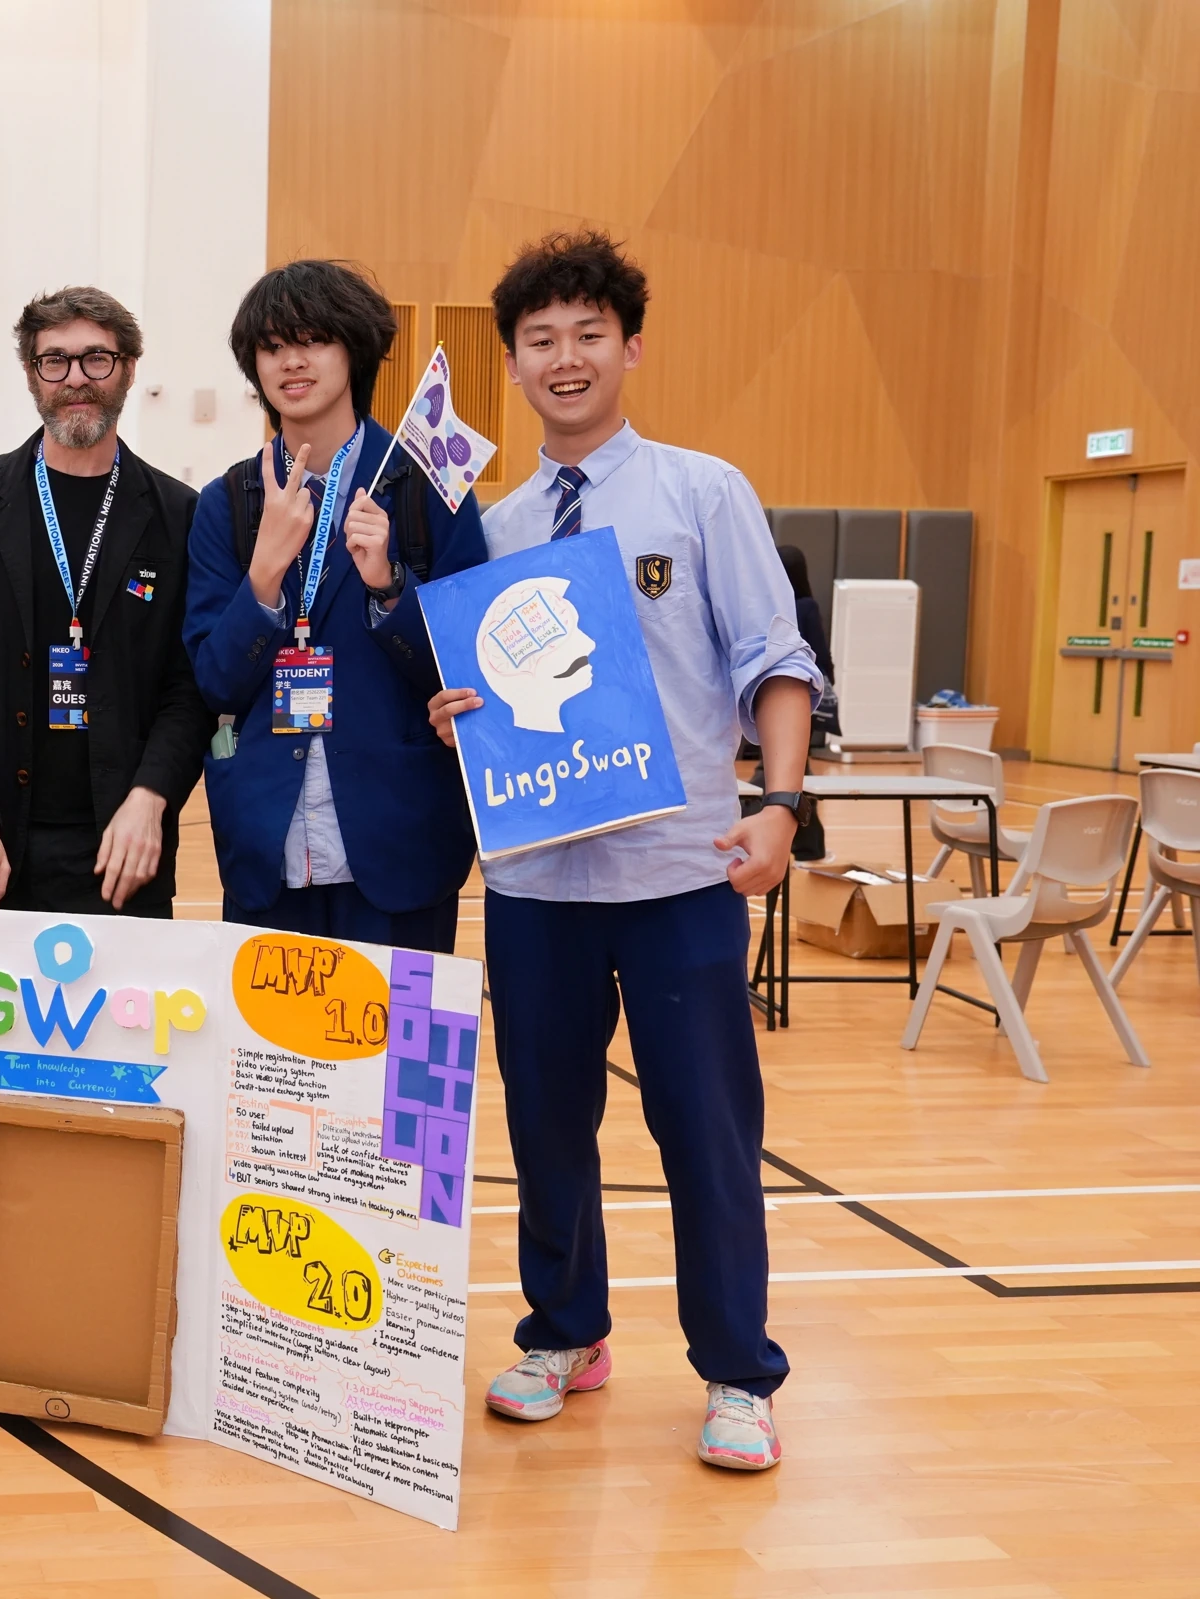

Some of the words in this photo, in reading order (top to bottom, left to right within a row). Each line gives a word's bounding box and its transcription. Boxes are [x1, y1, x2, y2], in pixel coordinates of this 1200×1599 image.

[331, 450, 347, 477] HKEO
[37, 461, 48, 489] HKEO
[41, 489, 64, 560] INVITATIONAL
[80, 517, 107, 587] INVITATIONAL
[100, 487, 115, 516] MEET
[110, 464, 120, 487] 2026
[314, 480, 338, 556] INVITATIONAL
[59, 561, 72, 588] MEET
[308, 558, 321, 590] MEET
[275, 668, 330, 678] STUDENT
[53, 680, 71, 690] 嘉宾
[275, 681, 291, 689] 学生
[53, 694, 87, 704] GUES
[251, 946, 338, 997] MVP
[325, 999, 388, 1046] 1.0
[4, 1054, 30, 1069] Turn
[37, 1060, 86, 1077] knowledge
[238, 1048, 263, 1061] Simple
[265, 1052, 306, 1066] registration
[236, 1070, 253, 1079] Basic
[275, 1075, 296, 1087] upload
[298, 1079, 327, 1090] function
[260, 1064, 287, 1078] viewing
[290, 1068, 315, 1079] system
[36, 1078, 56, 1088] into
[234, 1081, 275, 1094] Credit-based
[276, 1087, 304, 1101] exchange
[306, 1091, 330, 1102] system
[236, 1108, 247, 1117] 50
[249, 1111, 265, 1120] user
[238, 1095, 269, 1115] Testing
[328, 1112, 367, 1129] Insights
[251, 1145, 276, 1157] shown
[279, 1150, 306, 1161] interest
[236, 1172, 252, 1183] BUT
[255, 1177, 279, 1188] seniors
[281, 1182, 305, 1193] showed
[308, 1188, 331, 1203] strong
[333, 1194, 358, 1205] interest
[360, 1199, 367, 1207] in
[368, 1201, 394, 1218] teaching
[236, 1204, 310, 1258] MVP
[396, 1254, 438, 1274] Expected
[397, 1268, 443, 1287] Outcomes
[304, 1260, 371, 1321] 2.0
[387, 1277, 403, 1289] More
[406, 1283, 421, 1292] user
[424, 1288, 466, 1307] participation
[379, 1330, 417, 1348] Increased
[420, 1342, 459, 1361] confidence
